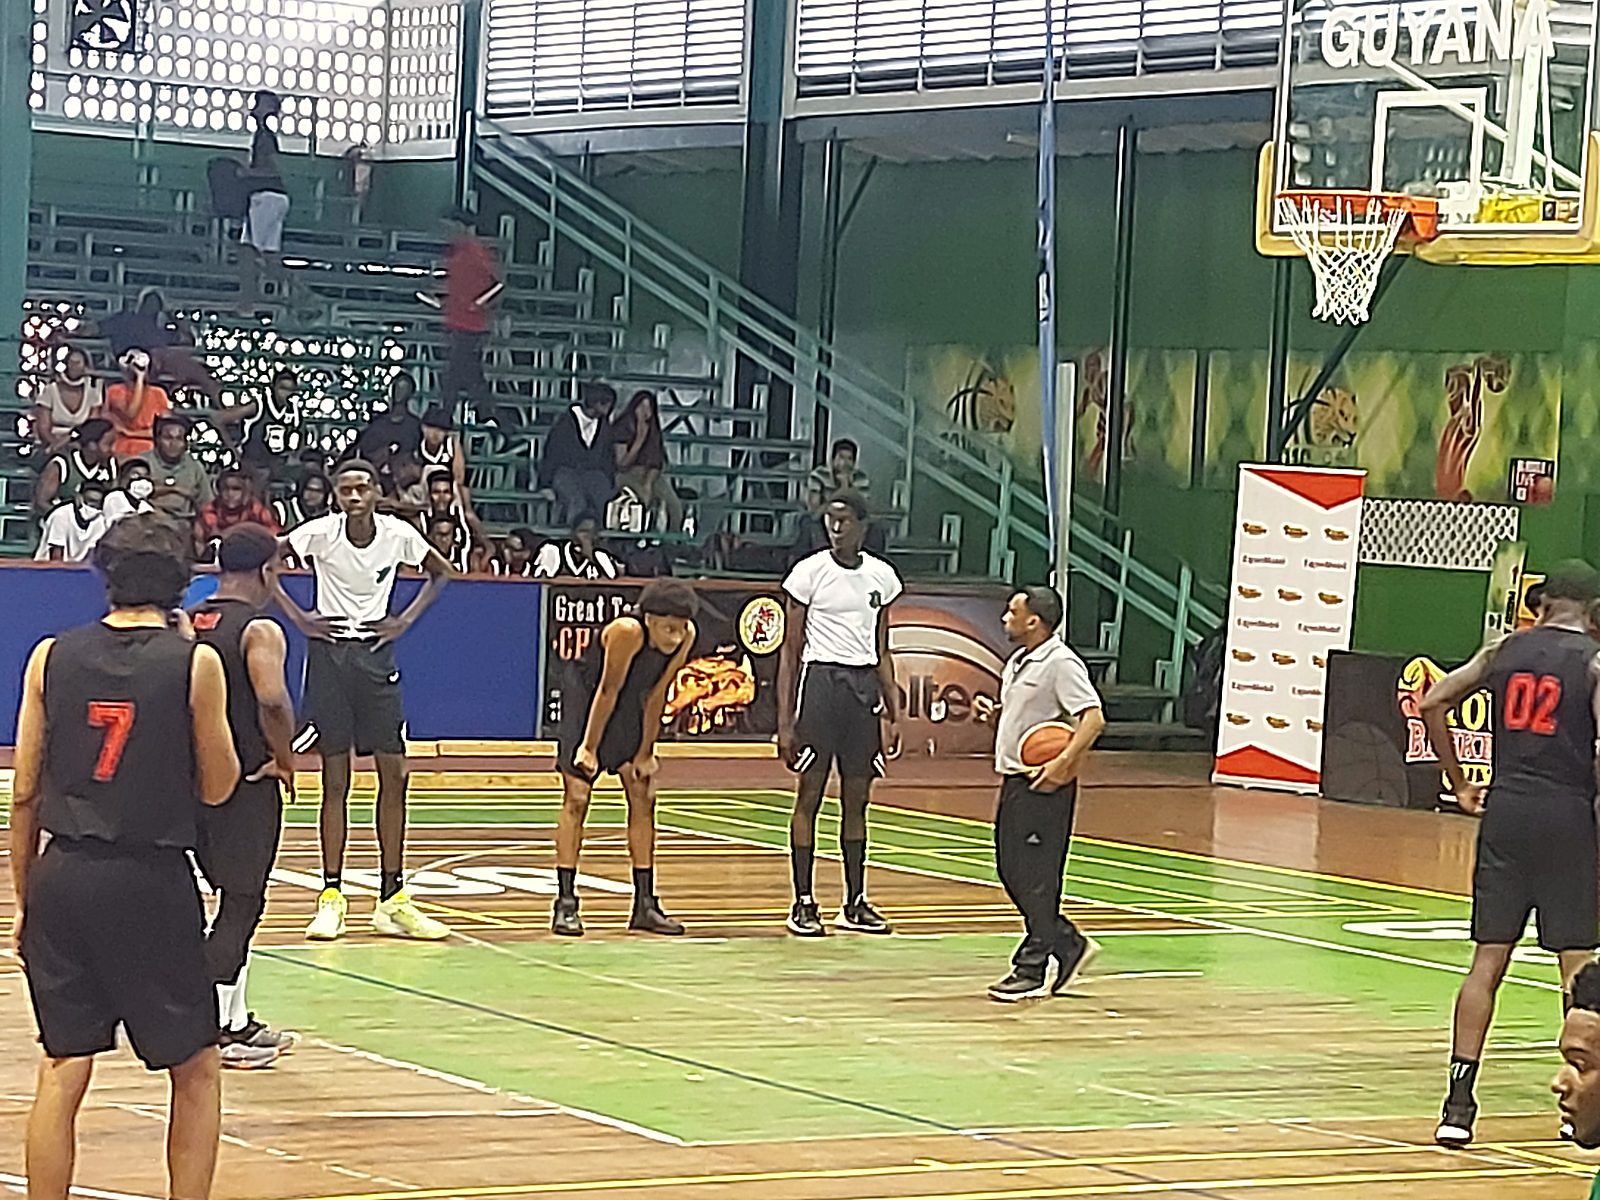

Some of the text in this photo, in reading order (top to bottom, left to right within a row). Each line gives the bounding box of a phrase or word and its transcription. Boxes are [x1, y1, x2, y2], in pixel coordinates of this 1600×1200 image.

[1321, 0, 1556, 68] GUYANA
[555, 594, 605, 624] Great
[1504, 672, 1562, 736] 02
[88, 700, 135, 782] 7
